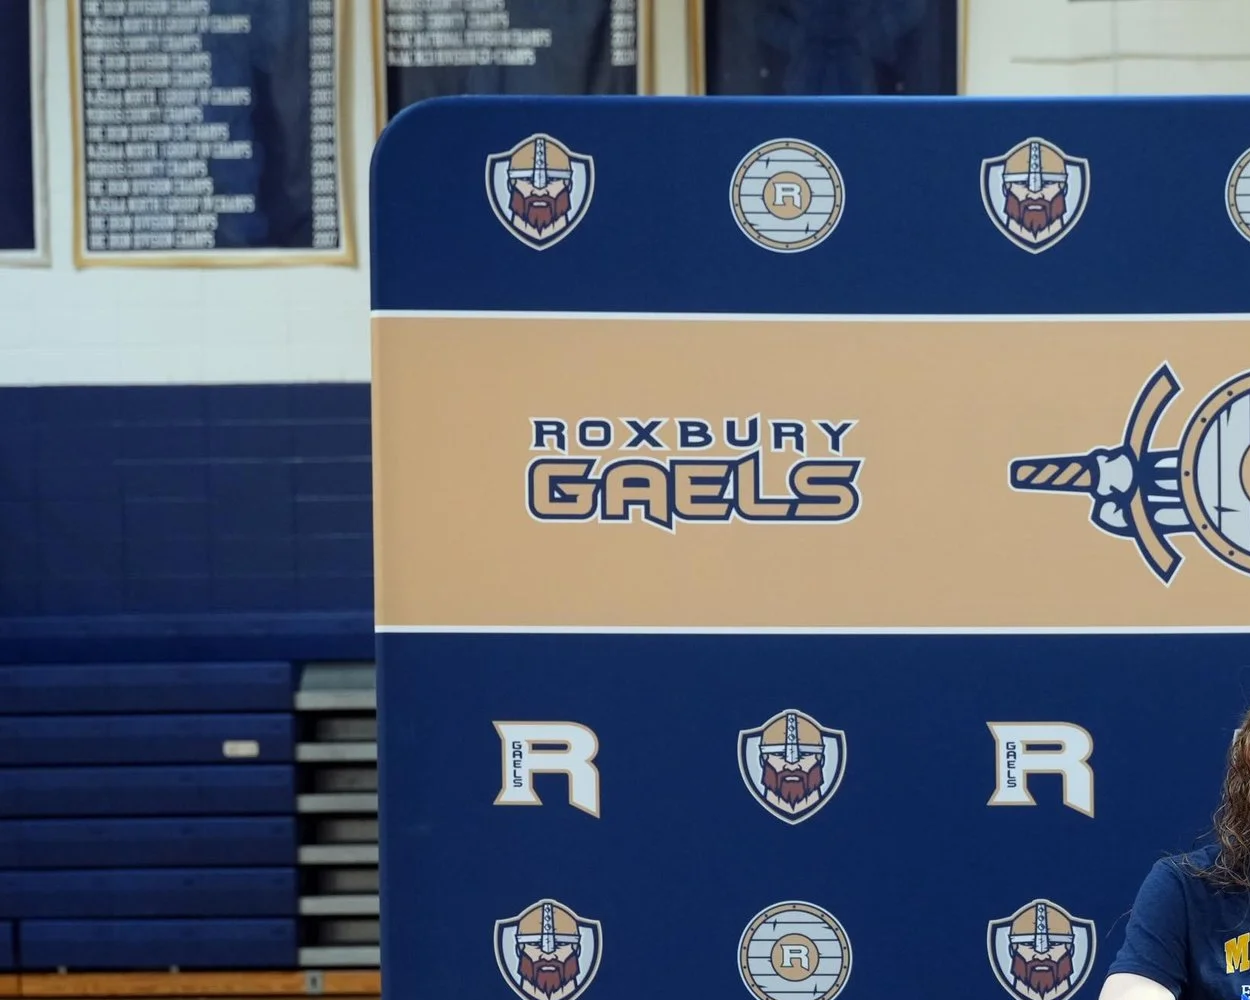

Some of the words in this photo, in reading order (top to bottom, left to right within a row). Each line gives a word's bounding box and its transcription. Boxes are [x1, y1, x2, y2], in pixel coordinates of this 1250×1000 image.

[529, 413, 859, 455] ROXBURY
[526, 448, 866, 535] GAELS
[492, 720, 600, 819] R
[511, 740, 523, 789] GAELS
[985, 721, 1095, 819] R
[1005, 740, 1018, 789] GAELS
